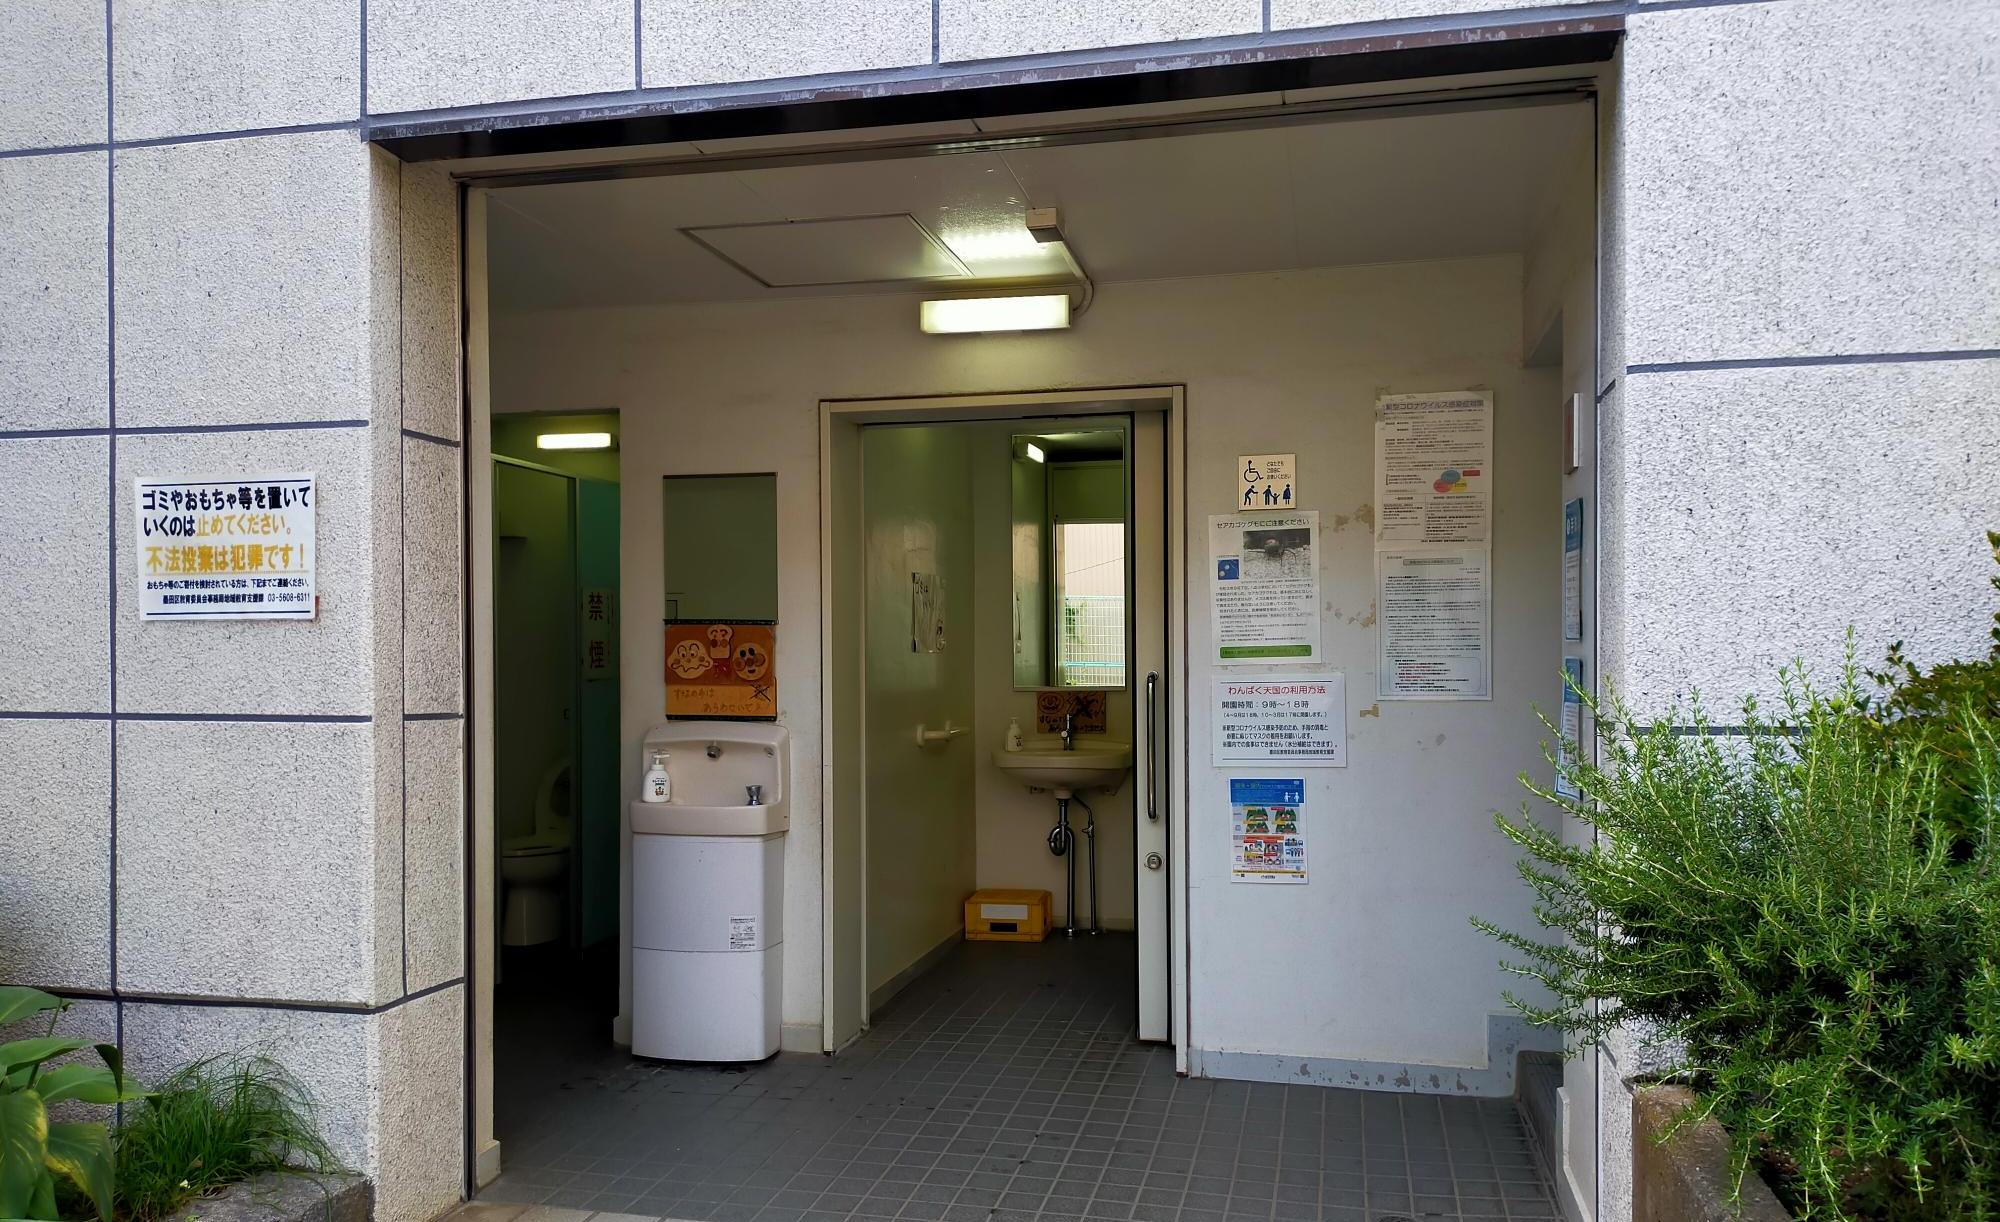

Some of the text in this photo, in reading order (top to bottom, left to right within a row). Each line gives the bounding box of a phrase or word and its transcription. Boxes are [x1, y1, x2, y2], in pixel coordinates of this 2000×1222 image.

[142, 486, 311, 511] ゴミやおもちゃ等を置いて
[143, 513, 292, 538] いくのは止めてください。
[1217, 519, 1310, 529] セアカゴケグモにご注意ください
[145, 543, 305, 573] 不法投棄は犯罪です！
[1228, 686, 1326, 695] わんぱく天国の利用方法
